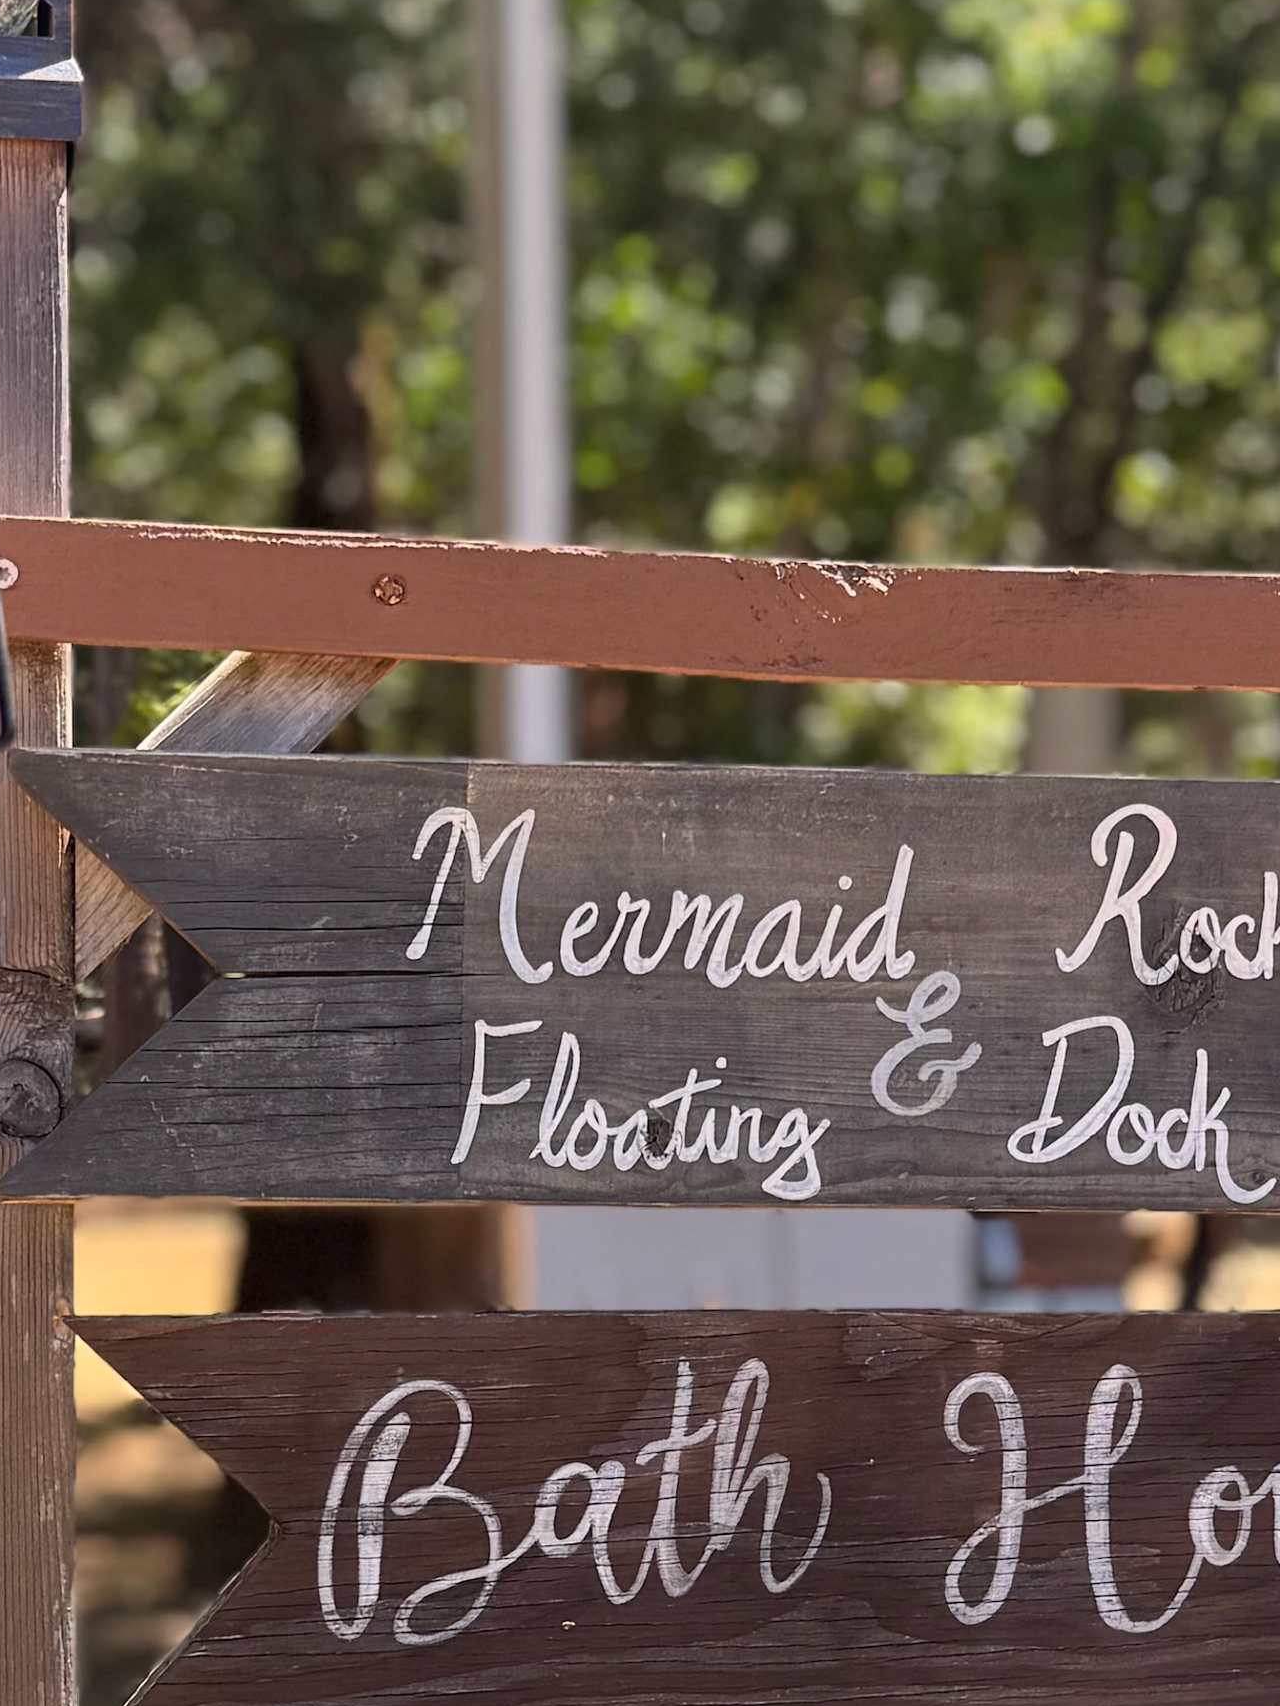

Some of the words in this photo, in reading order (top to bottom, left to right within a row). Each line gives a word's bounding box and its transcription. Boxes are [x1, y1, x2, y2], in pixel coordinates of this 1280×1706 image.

[406, 806, 915, 988] Mermaid
[451, 1018, 832, 1199] Floating
[1007, 1015, 1278, 1205] Dock
[873, 970, 983, 1117] &
[316, 1357, 831, 1645] Bath
